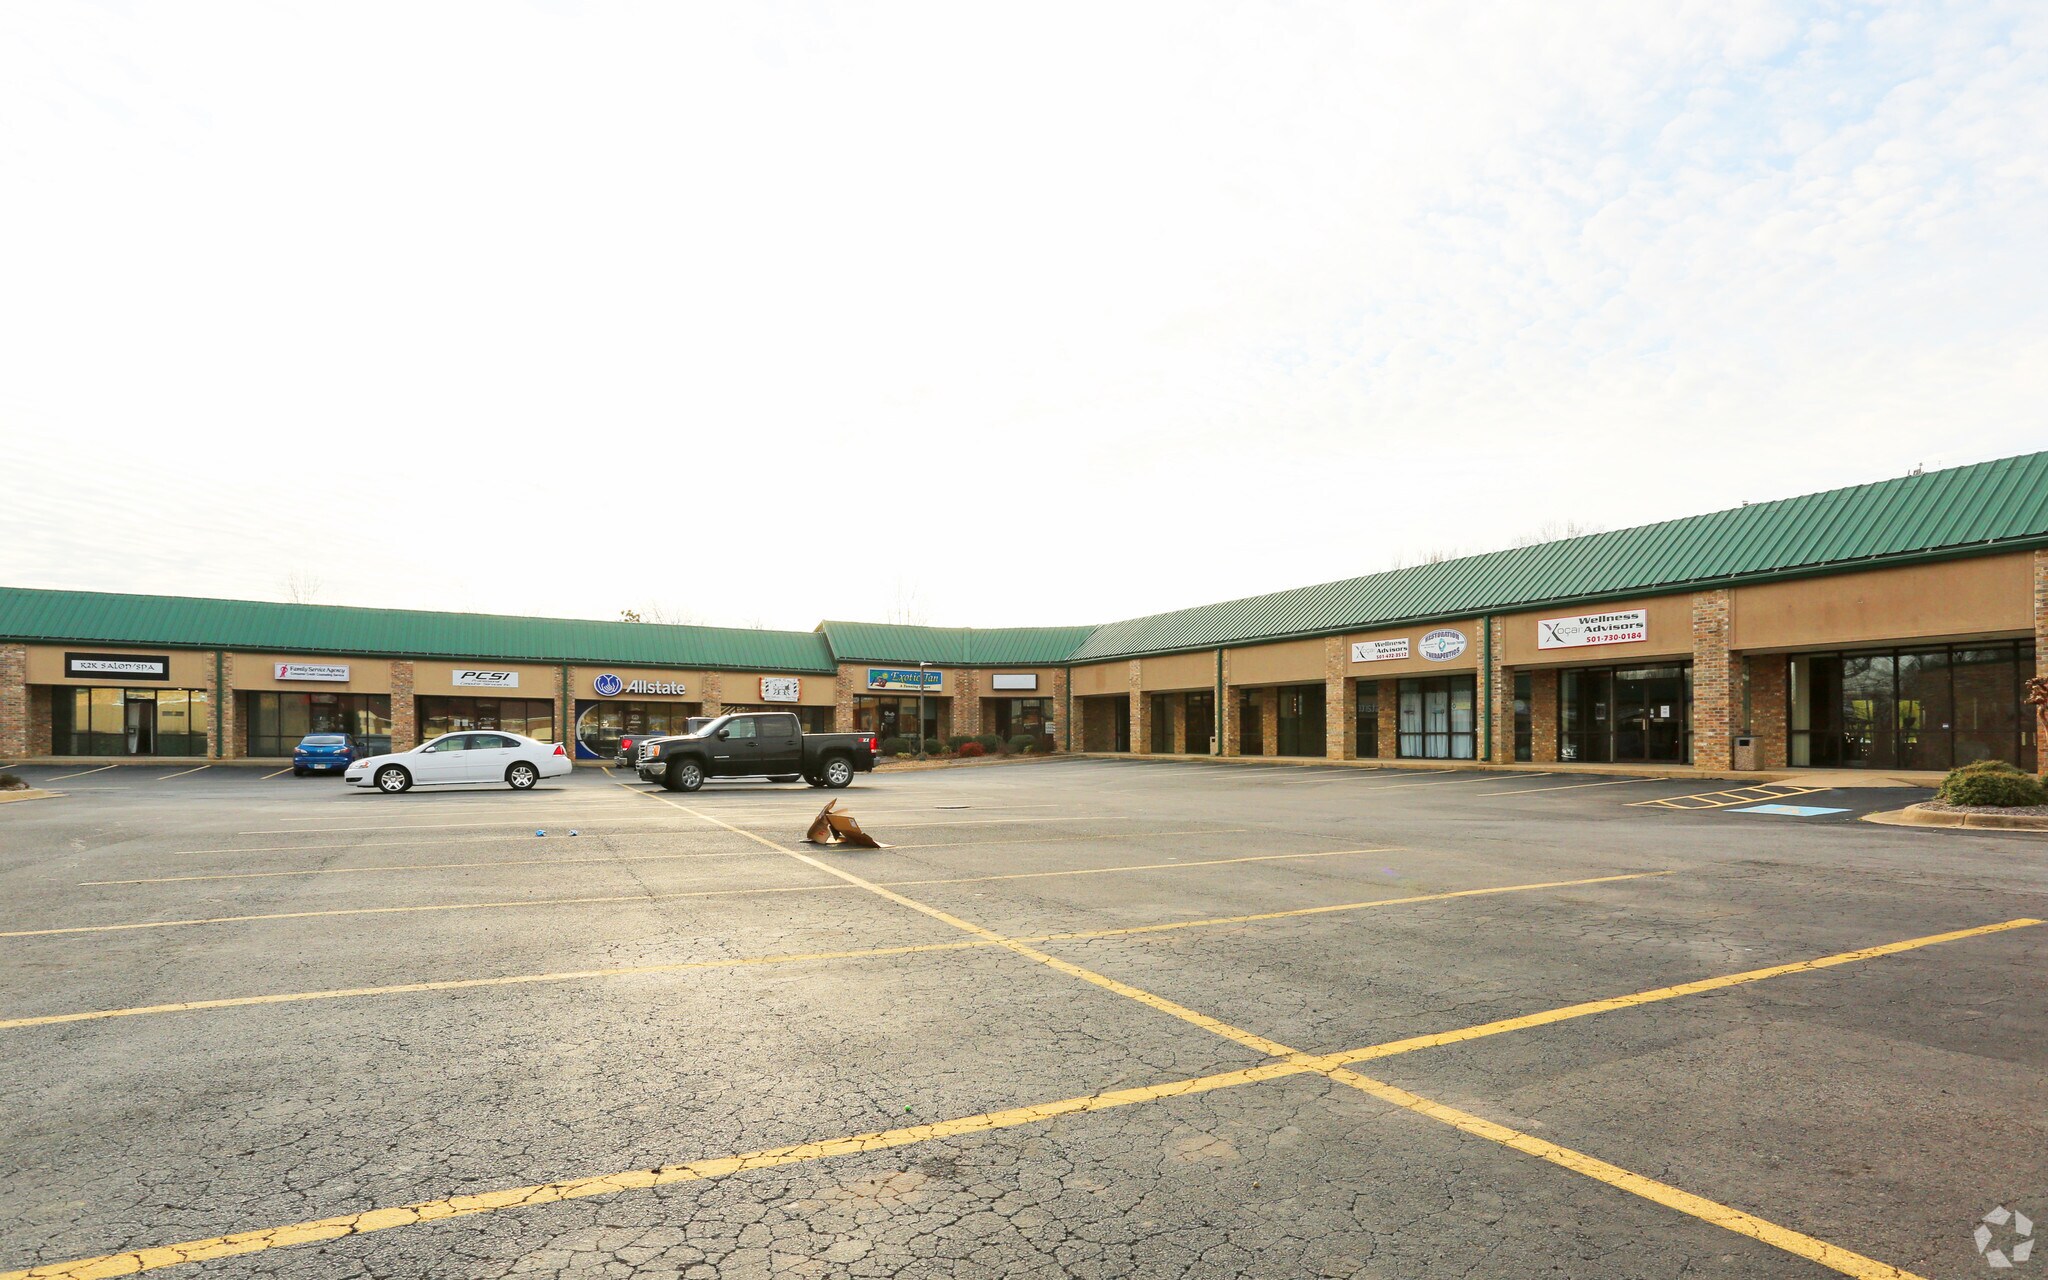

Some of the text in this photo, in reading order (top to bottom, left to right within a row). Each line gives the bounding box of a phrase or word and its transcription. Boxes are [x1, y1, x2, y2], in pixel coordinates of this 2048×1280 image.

[1579, 613, 1639, 625] Wellness
[1584, 622, 1644, 633] Advisors
[1586, 632, 1642, 643] 501-730-0184
[1374, 640, 1407, 648] Wellness
[461, 671, 511, 681] PCSI
[891, 671, 919, 683] Exotic
[626, 679, 686, 695] Allstate
